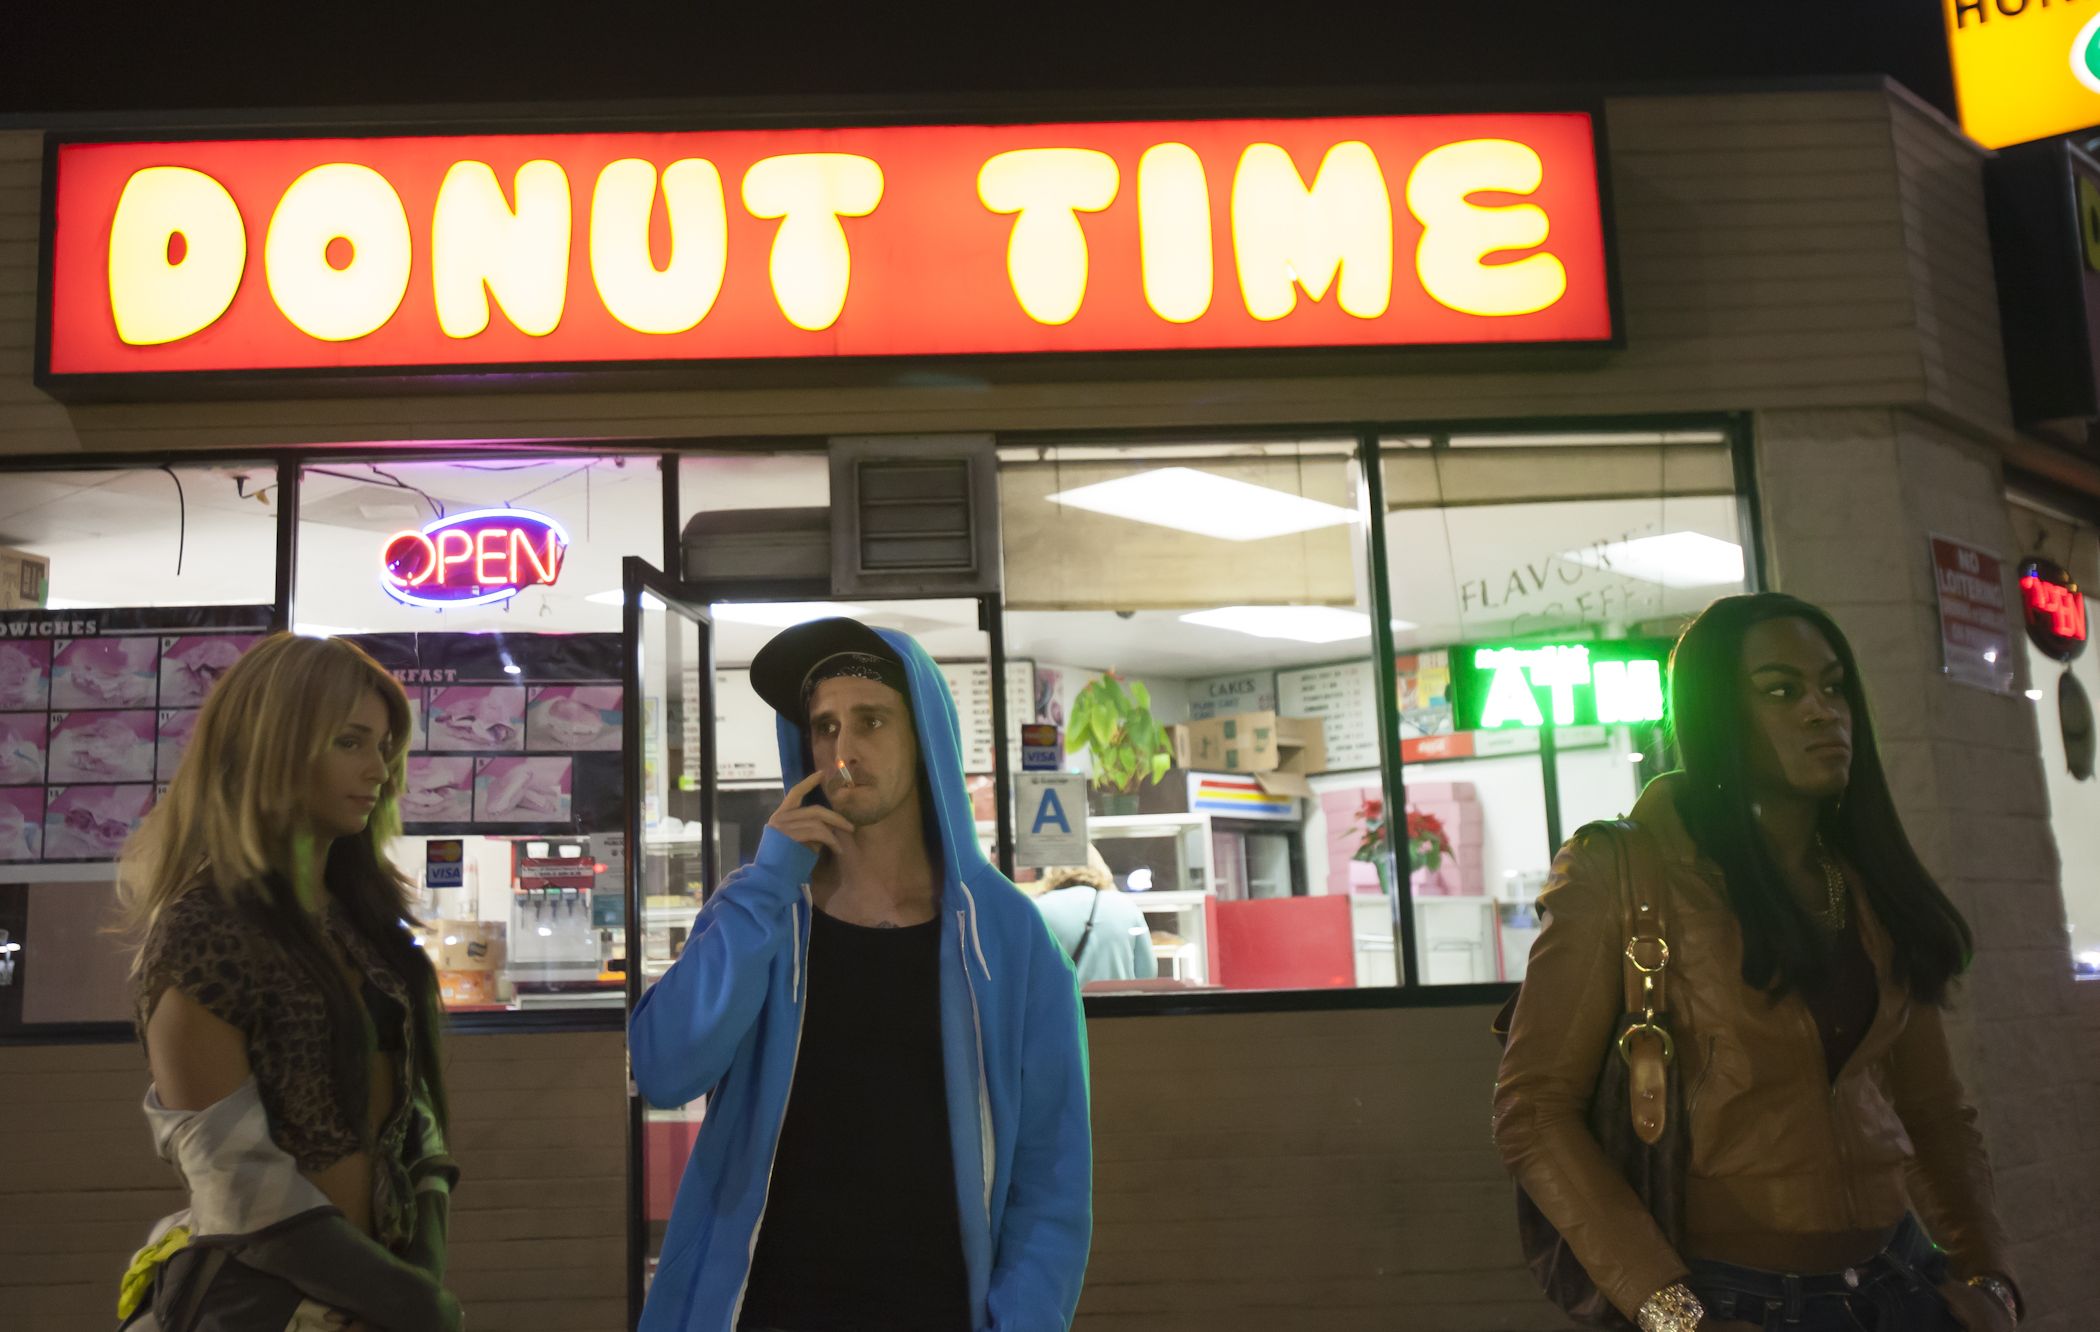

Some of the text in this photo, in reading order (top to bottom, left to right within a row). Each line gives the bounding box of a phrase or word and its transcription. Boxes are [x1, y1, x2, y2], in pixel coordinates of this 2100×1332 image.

[109, 139, 1566, 345] DONUT TIME
[380, 526, 558, 586] OPEN
[390, 669, 457, 683] KFAST
[1028, 752, 1056, 761] VISA
[1031, 788, 1071, 834] A
[432, 867, 461, 879] VISA
